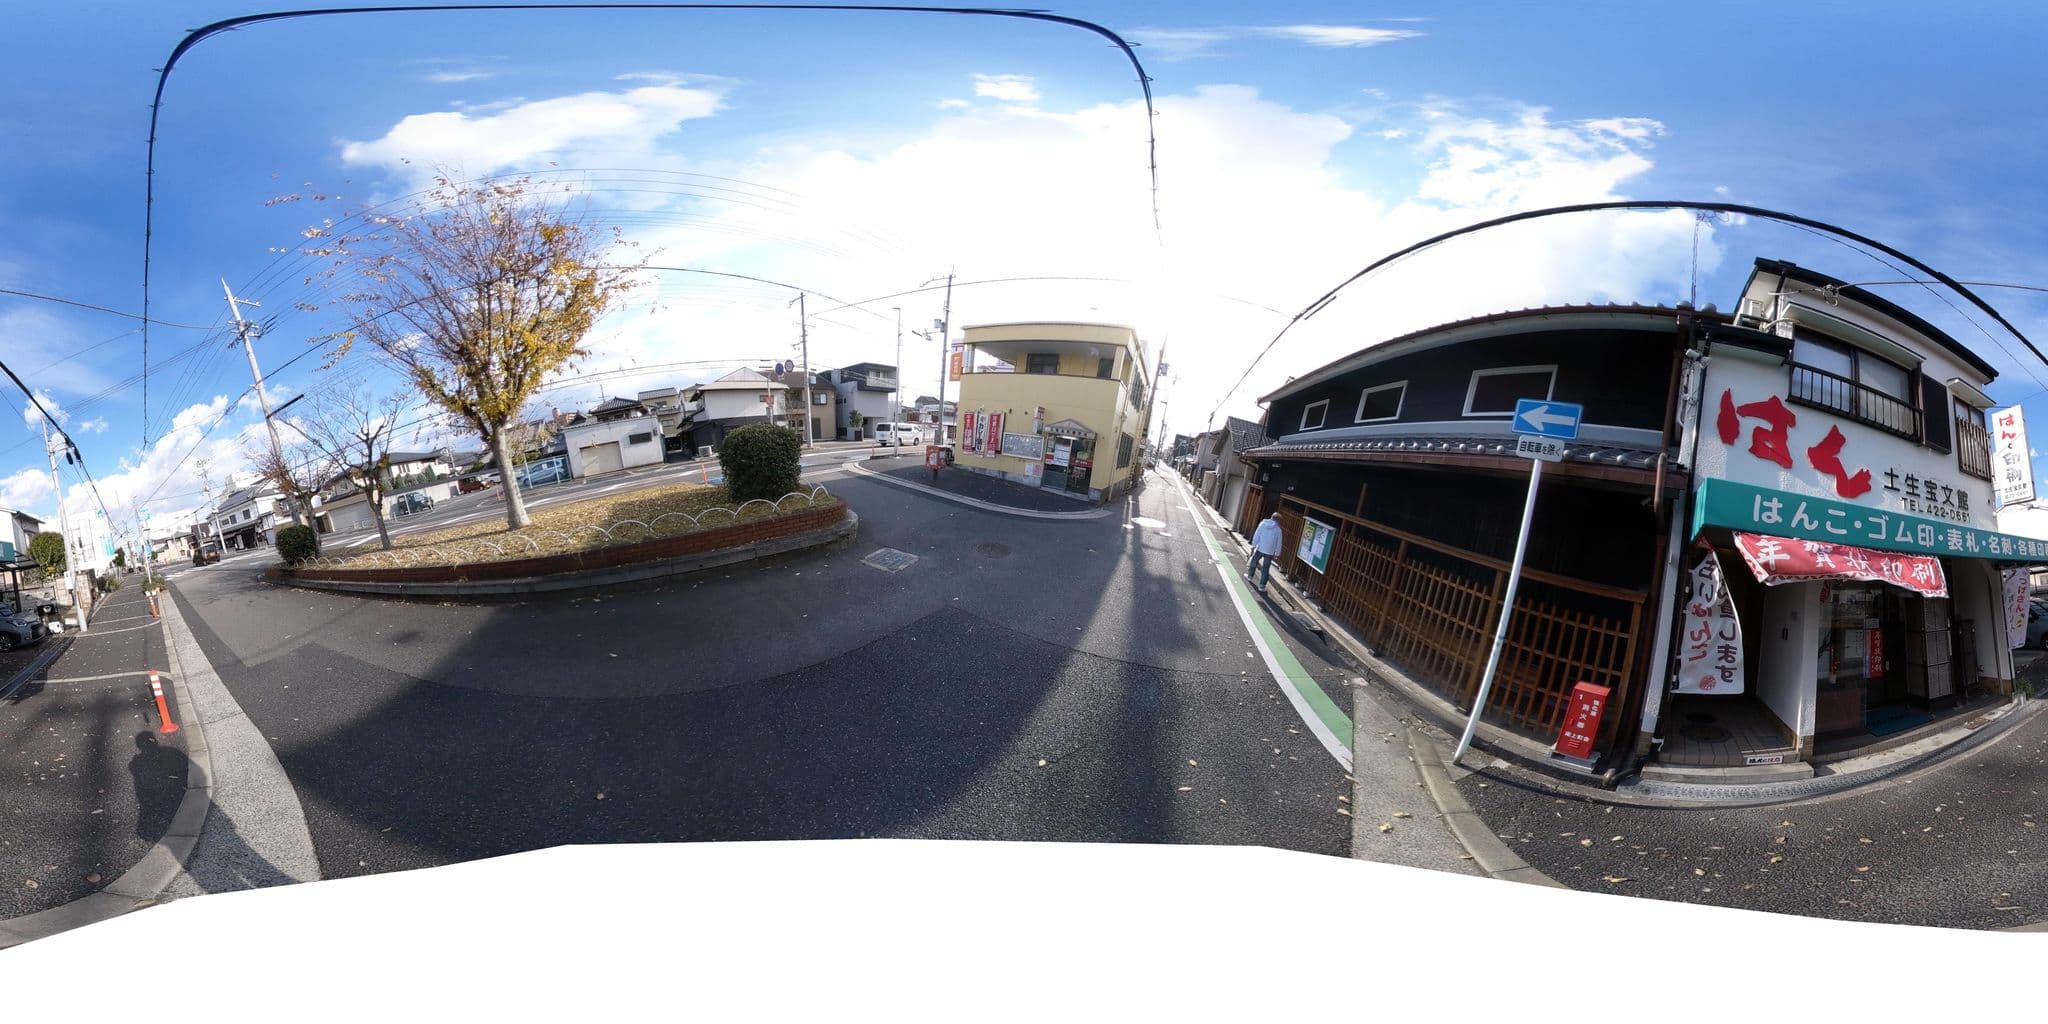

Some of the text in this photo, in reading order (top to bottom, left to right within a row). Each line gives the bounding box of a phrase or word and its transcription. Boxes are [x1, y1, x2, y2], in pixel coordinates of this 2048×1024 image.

[1520, 441, 1560, 456] 自転車を除く
[1884, 467, 1970, 511] 土生宝文館
[1902, 498, 1923, 513] TEL
